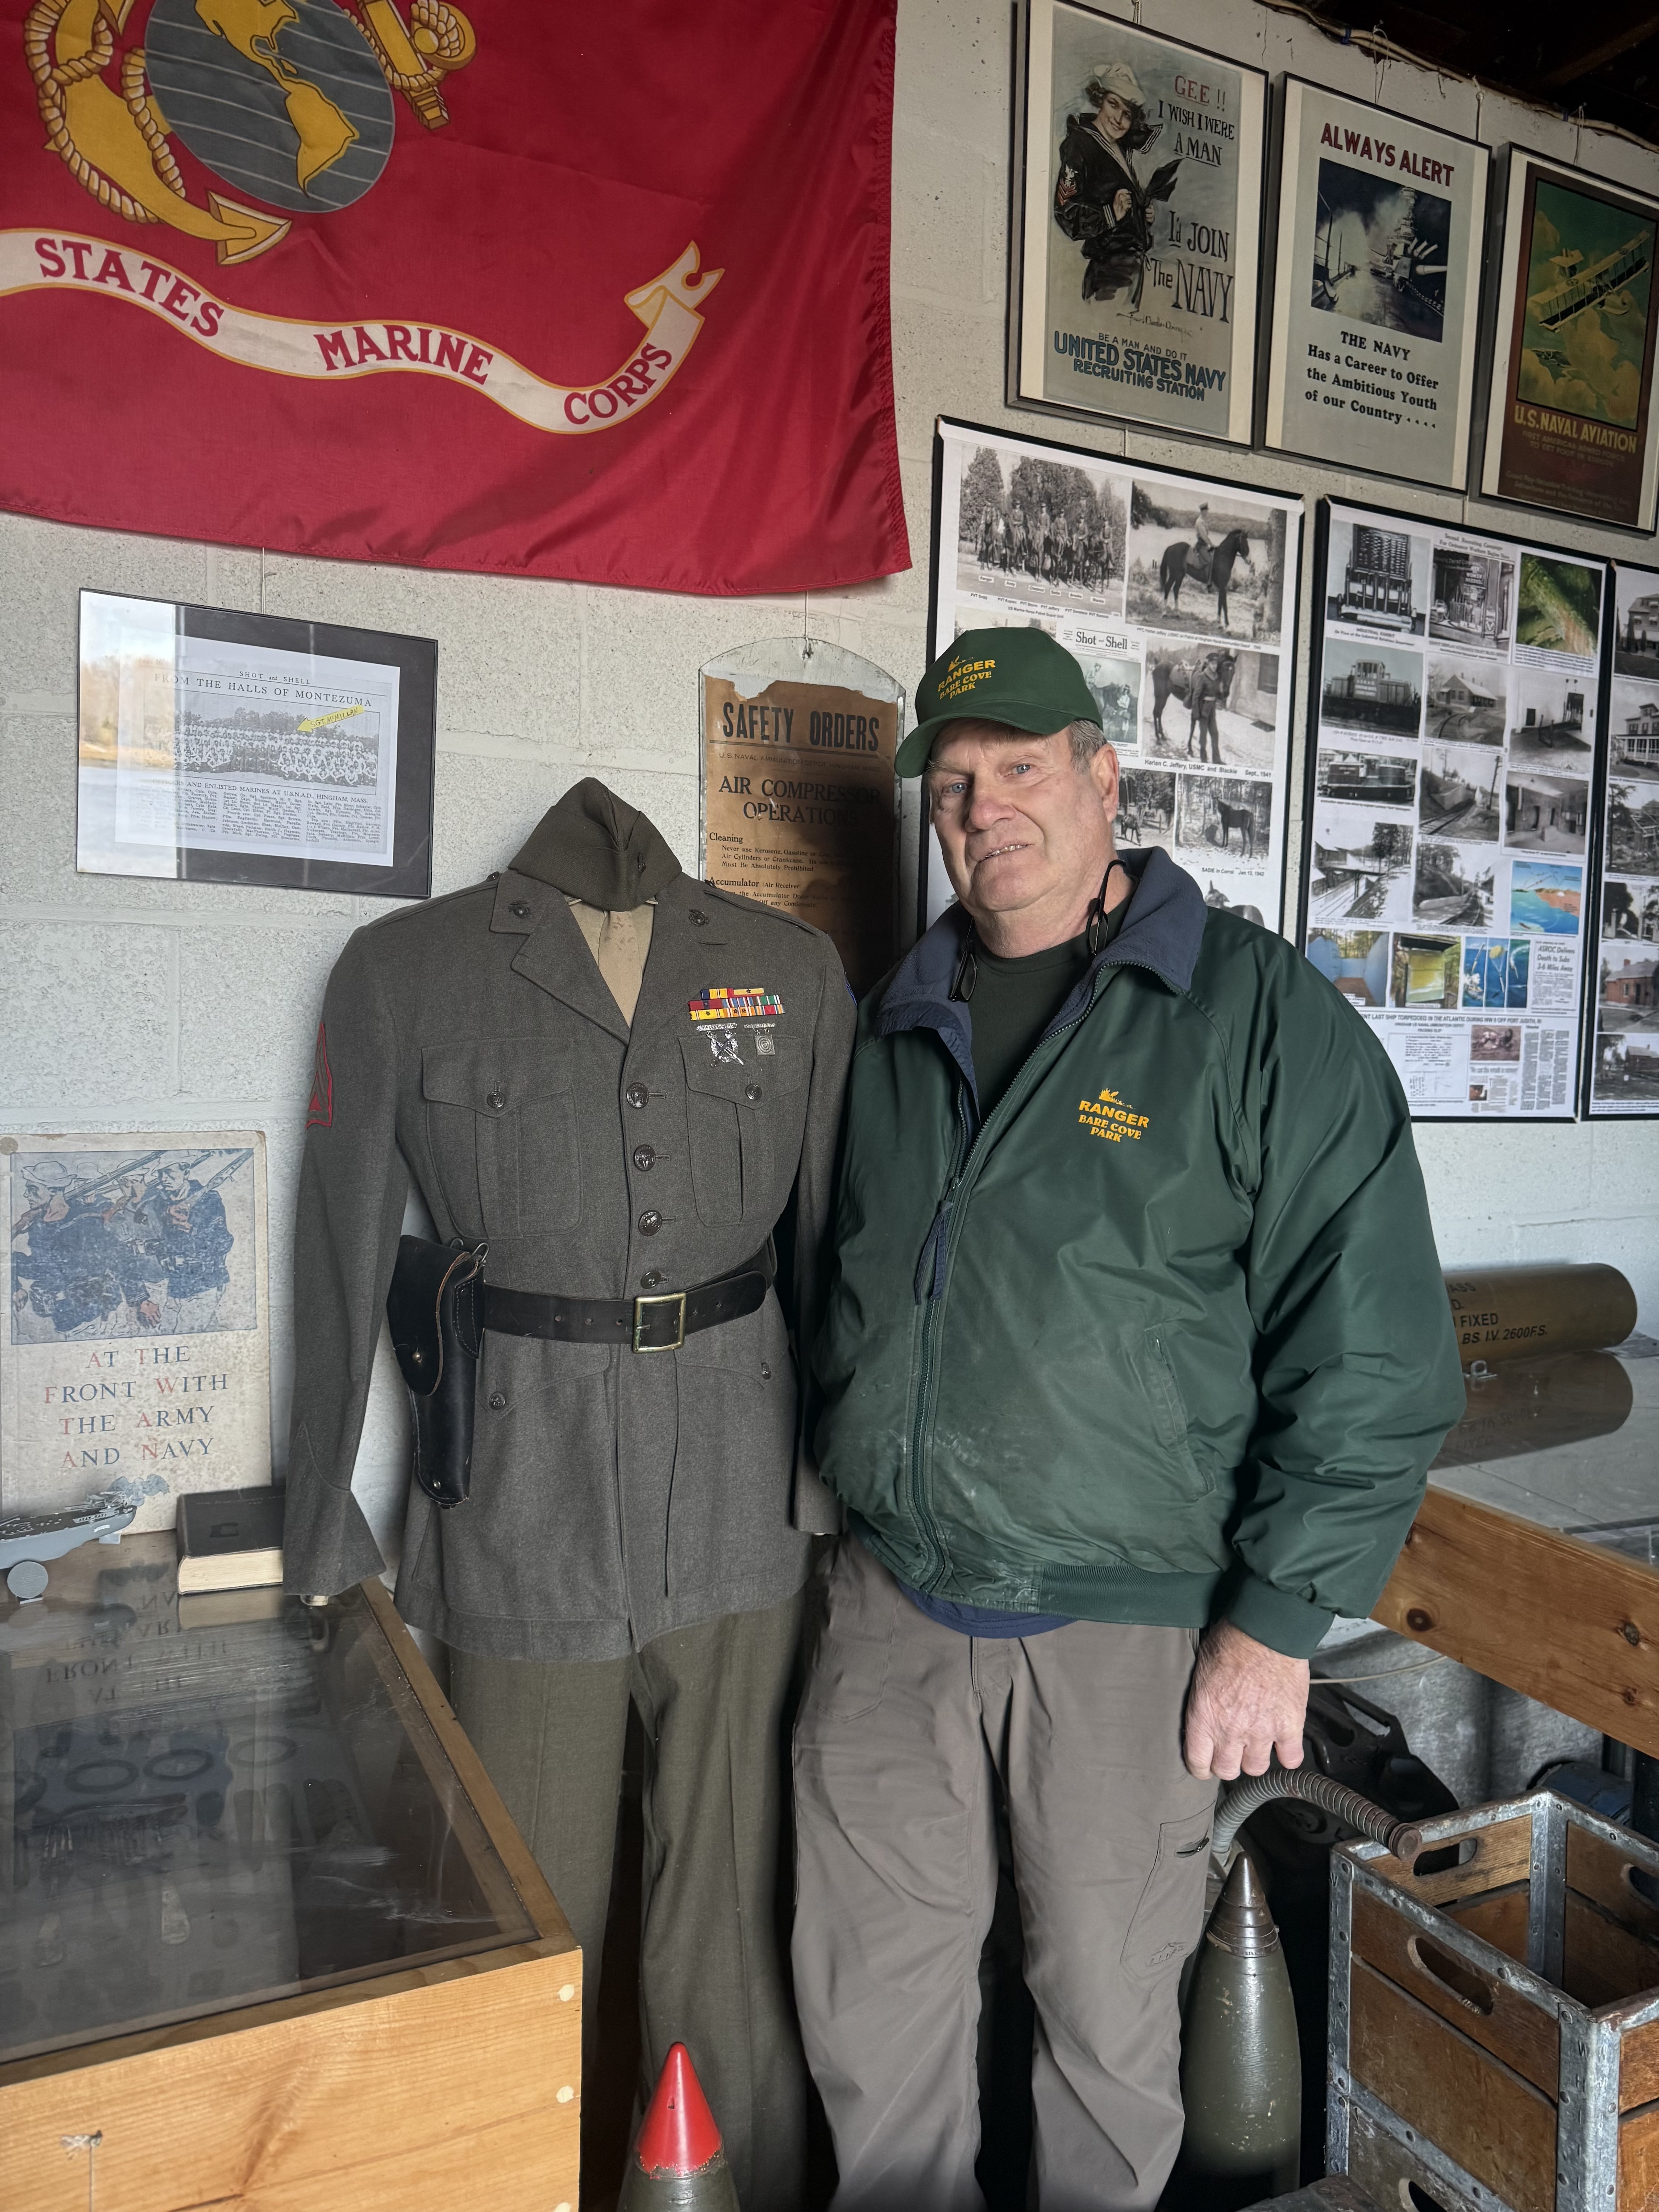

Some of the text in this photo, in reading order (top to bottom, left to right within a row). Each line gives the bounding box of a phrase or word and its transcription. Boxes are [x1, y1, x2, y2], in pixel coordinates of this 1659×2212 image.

[1175, 75, 1210, 104] GEE
[1158, 100, 1235, 140] I WISH I WERE
[1174, 132, 1223, 166] A MAN
[1320, 123, 1455, 187] ALWAYS ALERT
[1187, 222, 1230, 262] JOIN
[34, 237, 225, 337] STATES
[1151, 258, 1234, 324] The NAVY
[1054, 330, 1227, 392] UNITED STATES NAVY
[1098, 333, 1187, 361] BE A MAN AND DO IT
[1340, 331, 1411, 361] THE NAVY
[313, 324, 672, 425] MARINE CORPS
[1074, 358, 1205, 401] RECRUITING STATION
[1308, 344, 1439, 390] Has a Career to Offer
[1307, 367, 1437, 411] the Ambitious Youth
[1305, 390, 1319, 402] of
[1323, 395, 1346, 409] our
[1350, 400, 1402, 425] Country
[1514, 405, 1638, 454] U.S. NAVAL AVIATION
[1076, 631, 1097, 645] Shot
[1105, 636, 1127, 650] Shell
[938, 660, 996, 692] RANGER
[949, 682, 976, 699] PARK
[963, 671, 992, 684] COVE
[196, 678, 221, 688] THE
[228, 682, 267, 694] HALLS
[274, 688, 289, 696] OF
[295, 690, 372, 706] MONTEZUMA
[723, 702, 880, 751] SAFETY ORDERS
[761, 756, 803, 765] AMMUNITION
[718, 775, 881, 804] AIR COMPRESSOR
[709, 832, 744, 844] Cleaning
[709, 877, 759, 887] Accumulator
[1078, 1114, 1142, 1140] BARE COVE
[1079, 1100, 1149, 1128] RANGER
[1090, 1127, 1123, 1142] PARK
[1460, 1313, 1498, 1328] FIXED
[85, 1346, 191, 1368] AT THE
[45, 1374, 228, 1404] FRONT WITH
[59, 1405, 215, 1435] THE ARMY
[60, 1437, 215, 1468] AND NAVY
